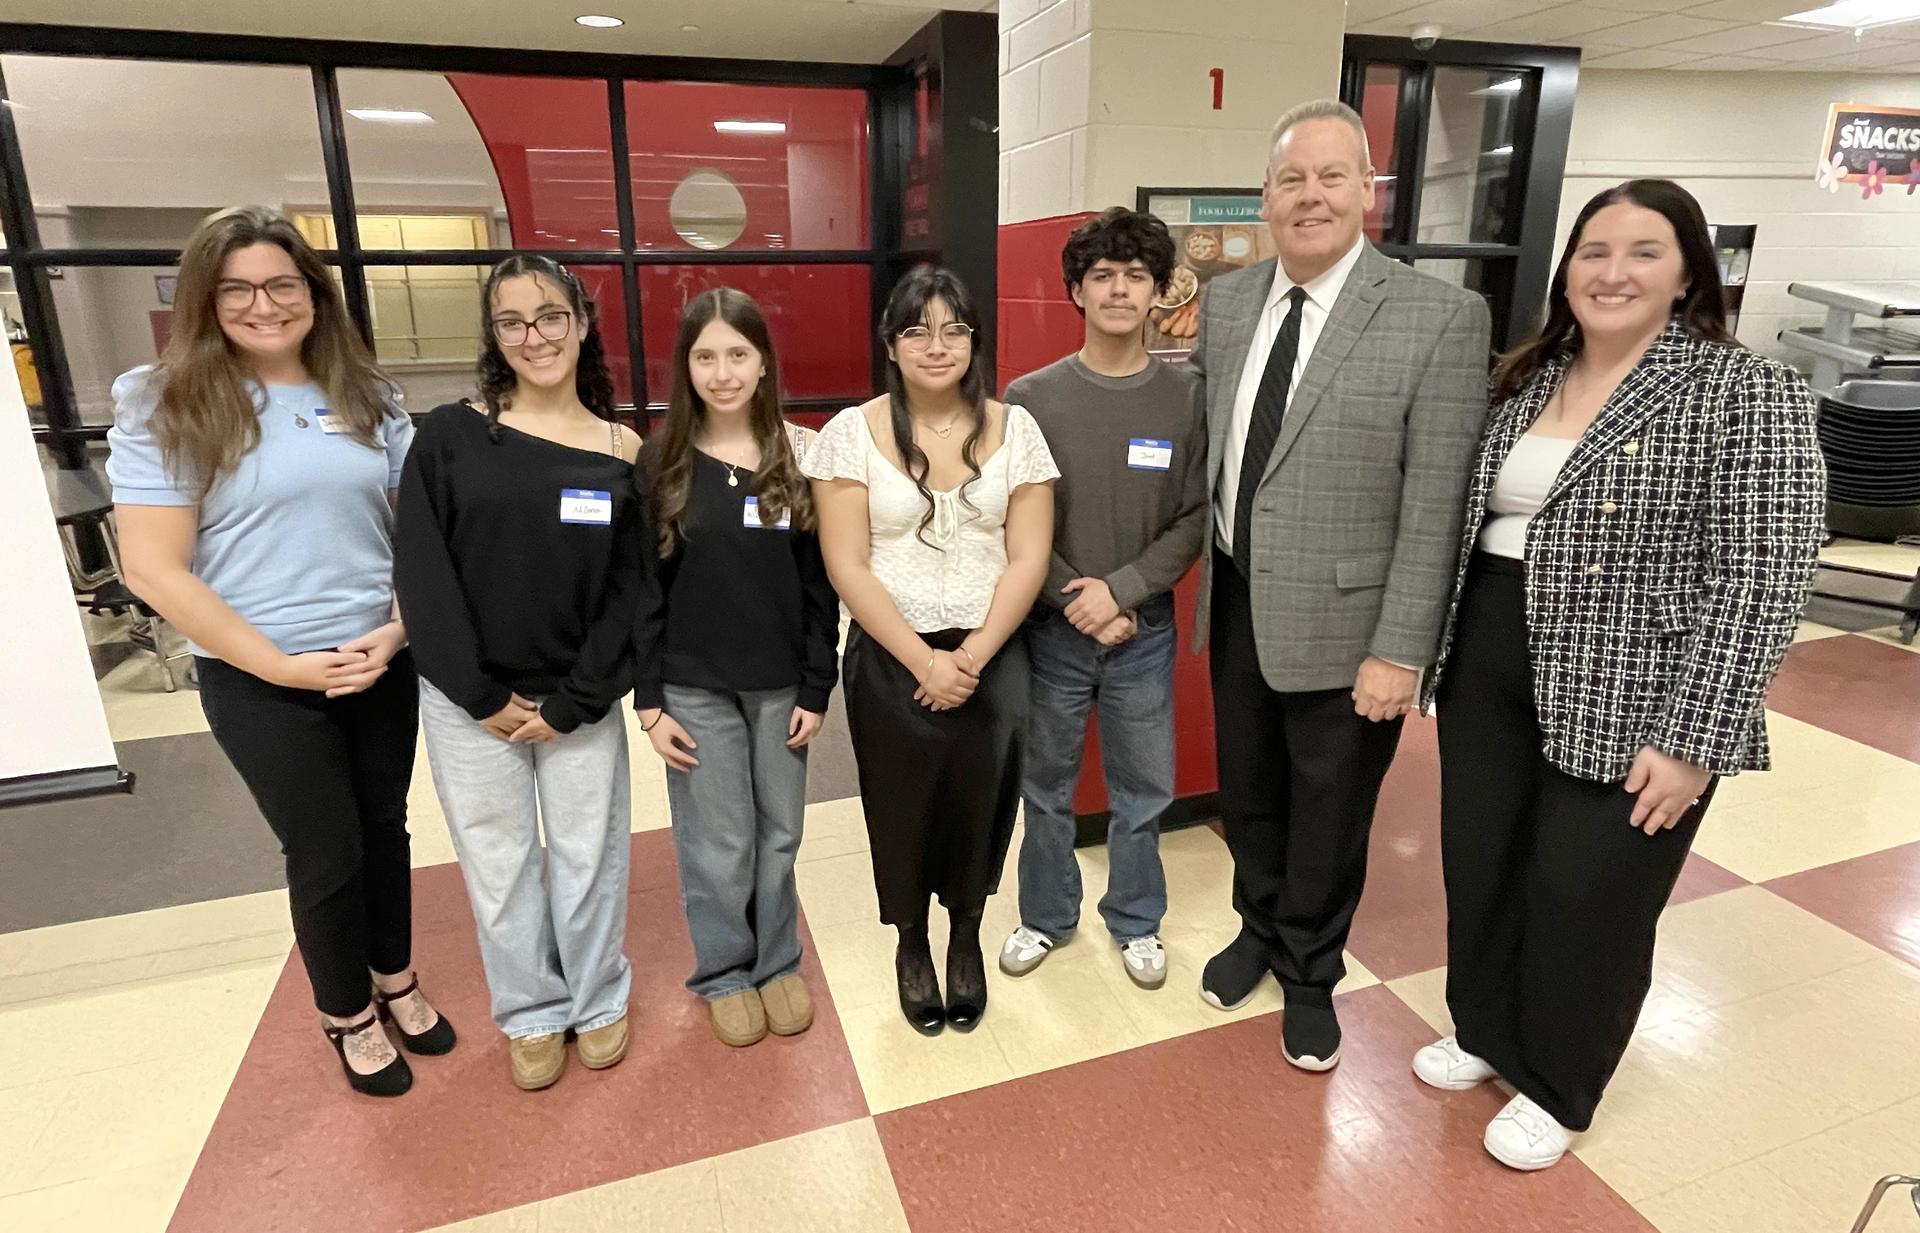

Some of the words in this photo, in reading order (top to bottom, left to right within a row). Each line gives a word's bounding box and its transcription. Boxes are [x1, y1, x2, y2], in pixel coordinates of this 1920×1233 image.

[1209, 67, 1224, 110] 1
[1198, 207, 1224, 217] FOOD
[1225, 207, 1261, 217] ALLERG
